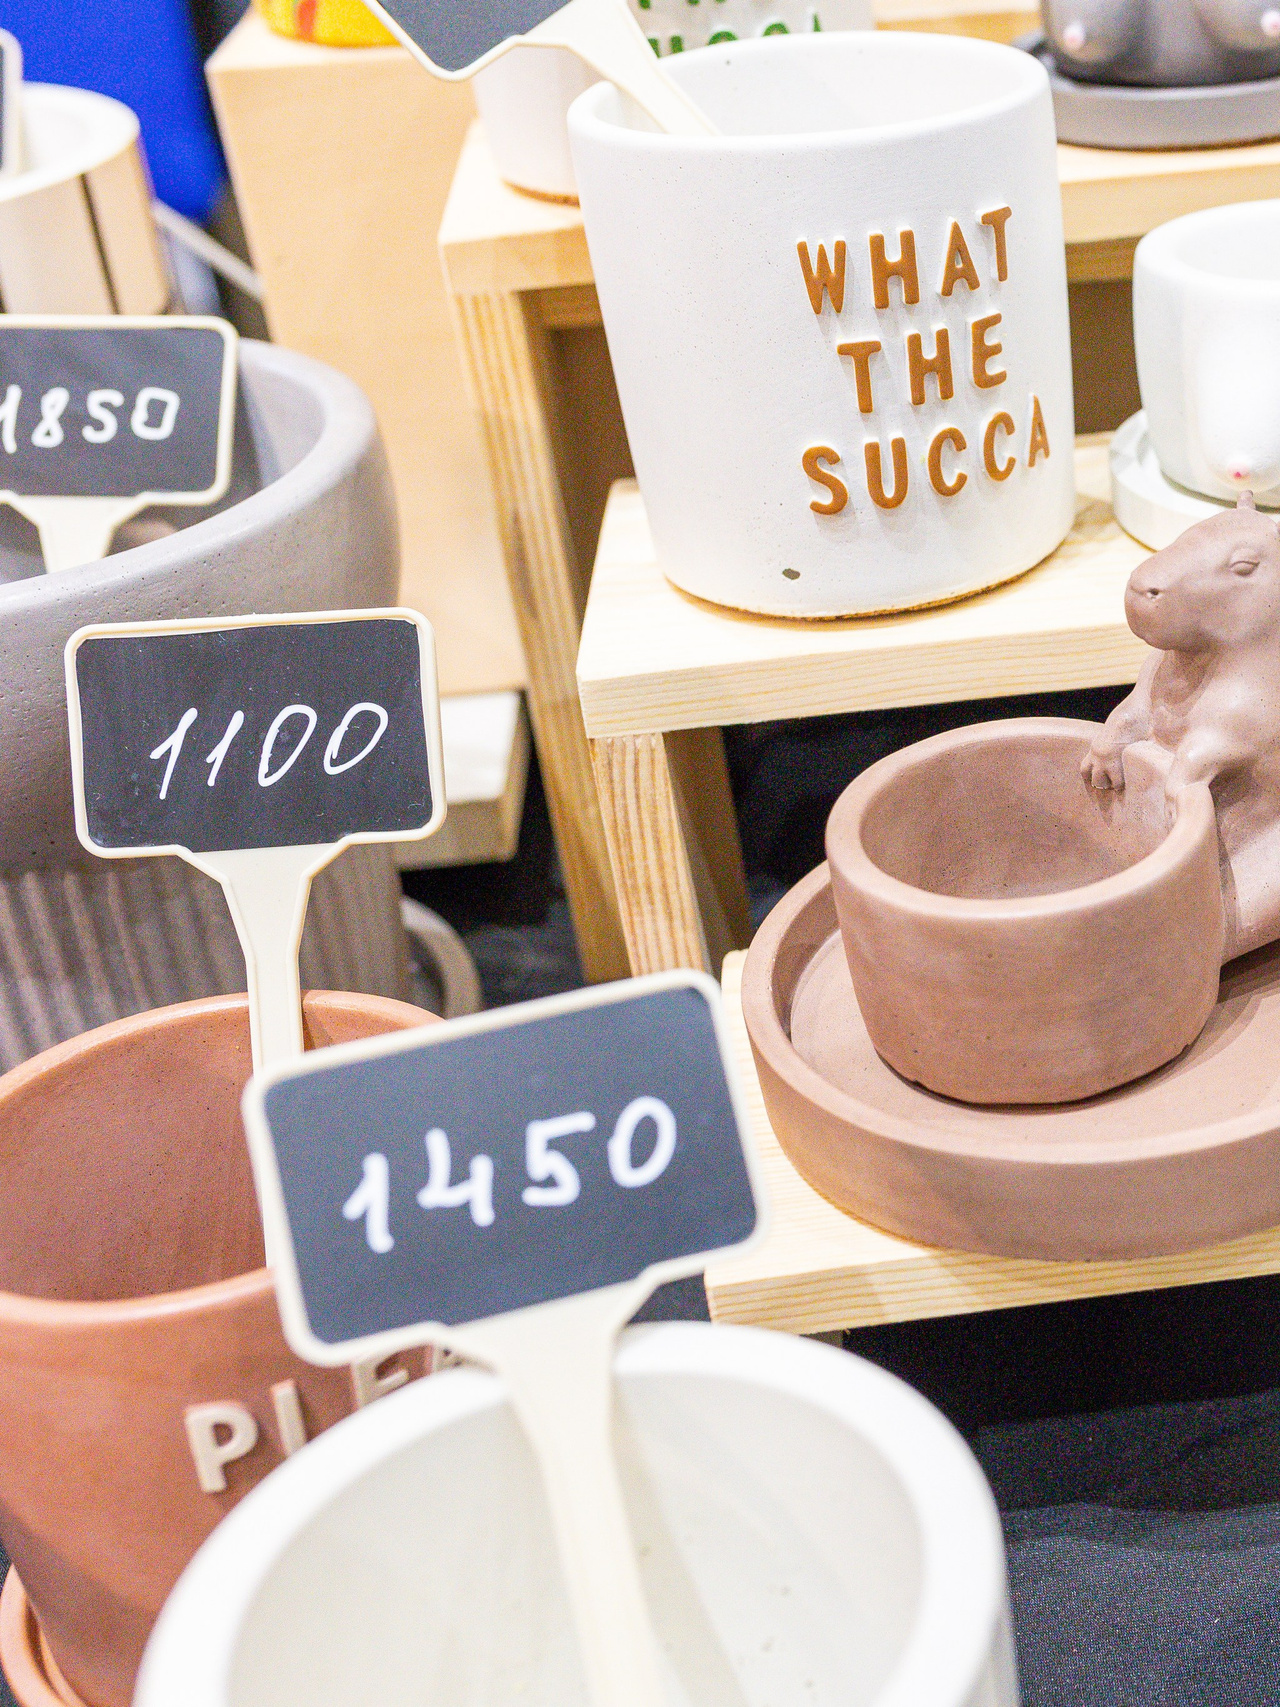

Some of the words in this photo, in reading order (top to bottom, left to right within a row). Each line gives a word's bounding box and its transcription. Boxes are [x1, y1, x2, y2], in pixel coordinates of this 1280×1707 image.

[796, 206, 1012, 316] WHAT
[836, 313, 1007, 414] THE
[0, 384, 181, 454] 1850
[802, 397, 1050, 516] SUCCA
[149, 702, 390, 801] 1100
[341, 1095, 679, 1255] 1450
